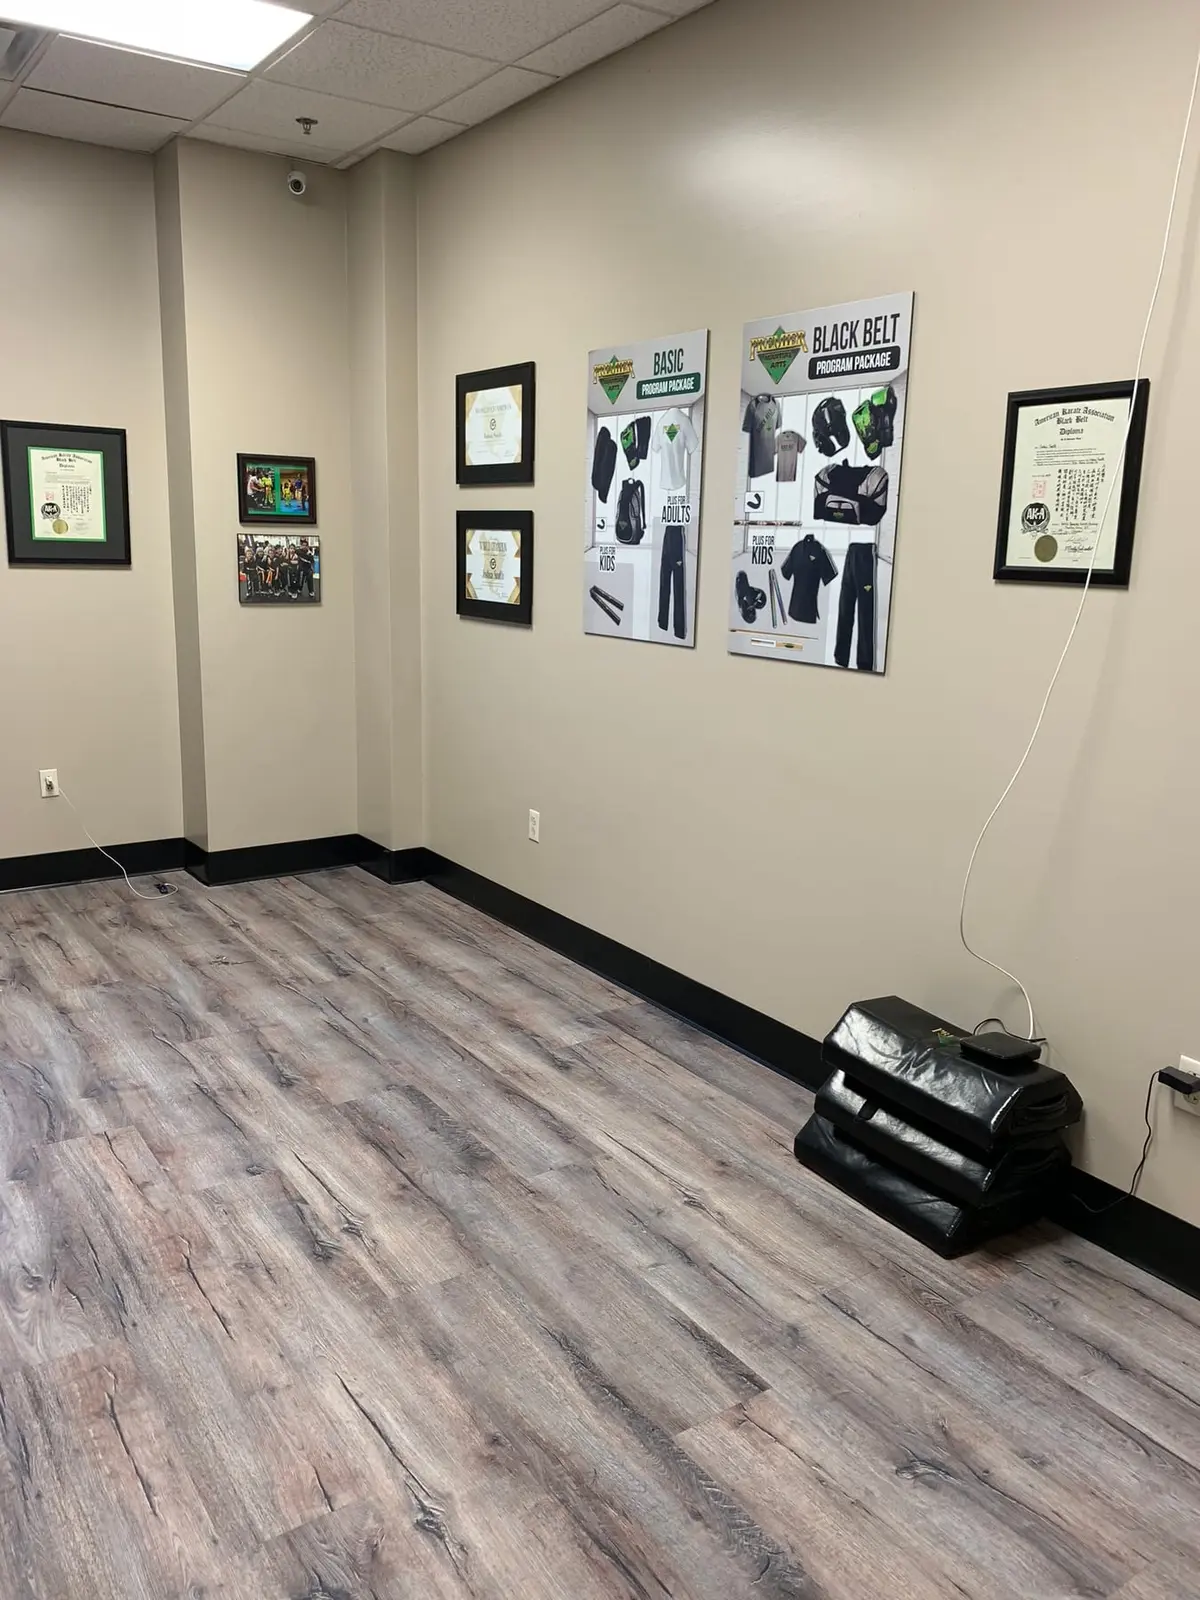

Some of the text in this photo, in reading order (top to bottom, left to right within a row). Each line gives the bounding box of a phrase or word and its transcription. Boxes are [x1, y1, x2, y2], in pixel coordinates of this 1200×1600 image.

[812, 312, 900, 354] BLACK BELT
[749, 329, 809, 361] PREMIER
[653, 347, 684, 376] BASIC
[769, 360, 787, 369] ARTS
[815, 351, 892, 376] PROGRAM PACKAGE
[641, 381, 668, 396] PROGRAM
[668, 376, 695, 392] PACKAGE
[1034, 406, 1115, 426] American Karate Association
[1056, 415, 1089, 425] Black Belt
[1059, 427, 1084, 436] Diploma
[667, 495, 686, 505] PLUS FOR
[661, 505, 691, 523] ADULTS
[752, 535, 775, 546] PLUS FOR
[600, 546, 609, 555] PLUS
[751, 545, 774, 565] KIDS
[599, 555, 616, 572] KIDS
